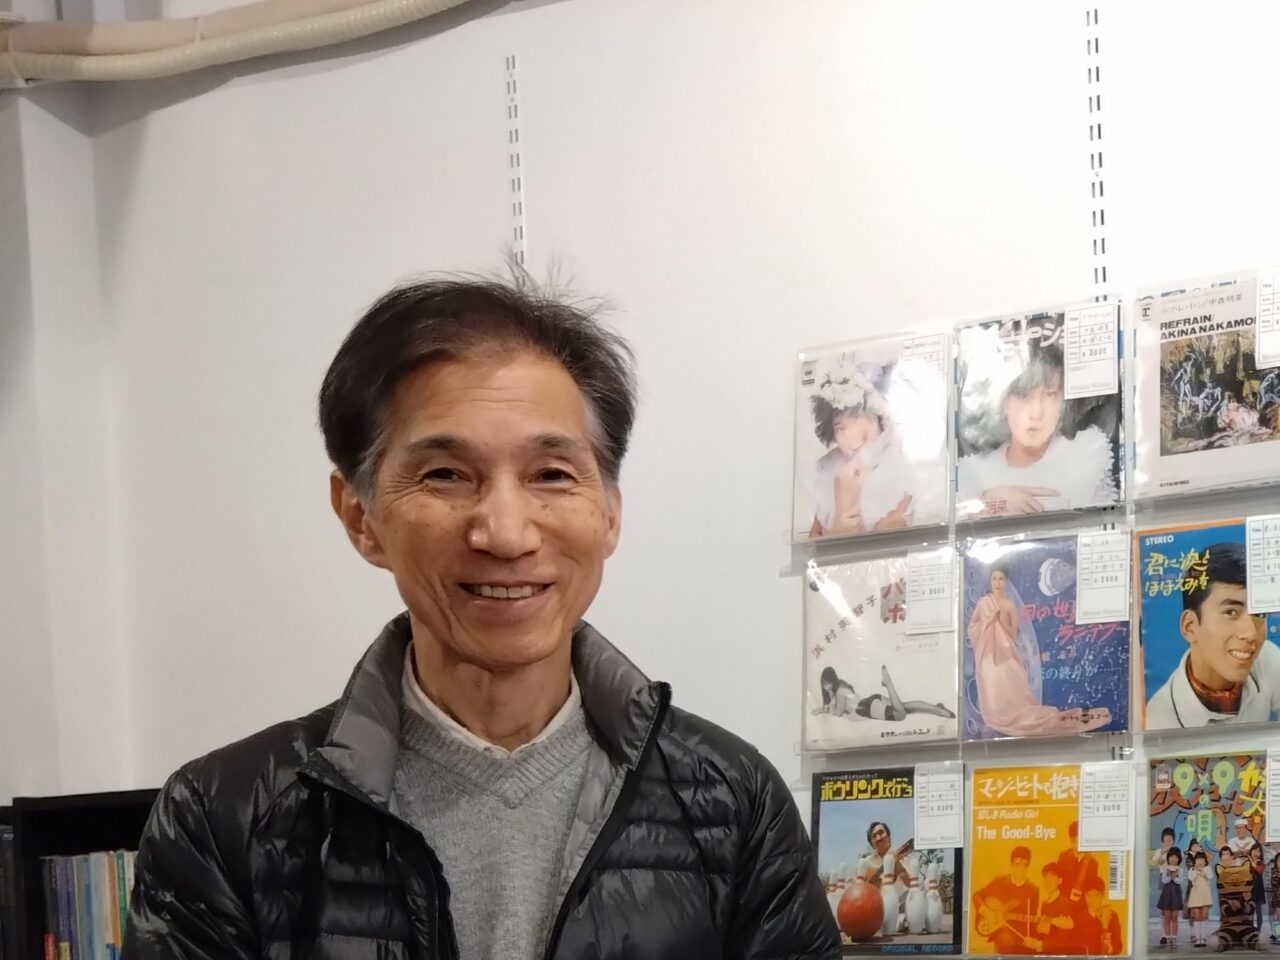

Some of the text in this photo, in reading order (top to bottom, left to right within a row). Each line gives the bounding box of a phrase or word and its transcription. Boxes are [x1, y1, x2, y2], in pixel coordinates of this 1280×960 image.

[1160, 316, 1256, 340] AKINA NAKAMO
[1145, 535, 1174, 546] STEREO
[976, 824, 1057, 841] The Good-Bye
